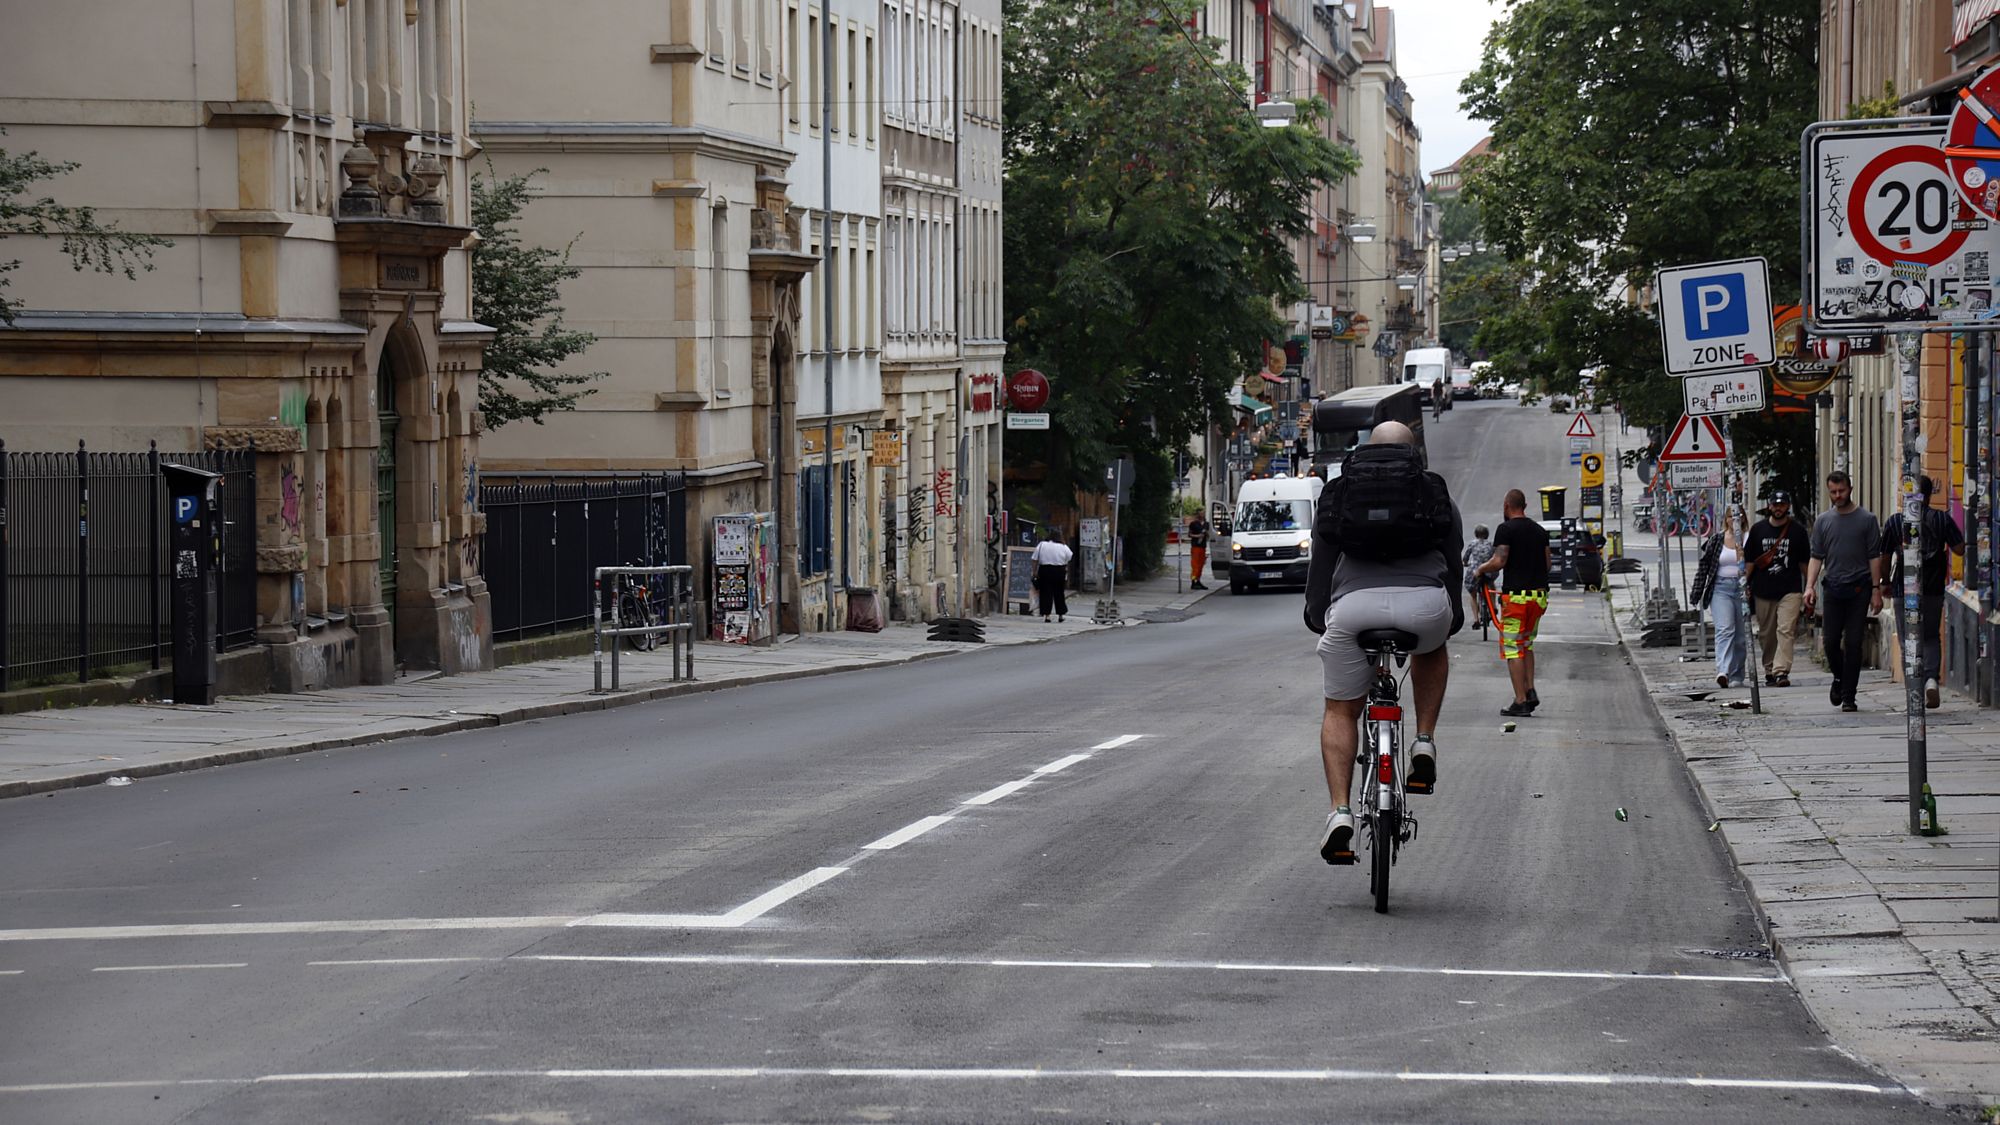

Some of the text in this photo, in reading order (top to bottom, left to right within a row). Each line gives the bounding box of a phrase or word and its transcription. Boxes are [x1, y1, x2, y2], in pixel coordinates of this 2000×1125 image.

[1878, 179, 1948, 236] 20
[1865, 278, 1960, 308] ZONE
[1697, 284, 1731, 331] P
[1693, 344, 1746, 365] ZONE
[1714, 381, 1733, 392] mit
[1692, 392, 1757, 408] Pachein
[1681, 475, 1708, 483] ausfahrt
[178, 498, 192, 518] P
